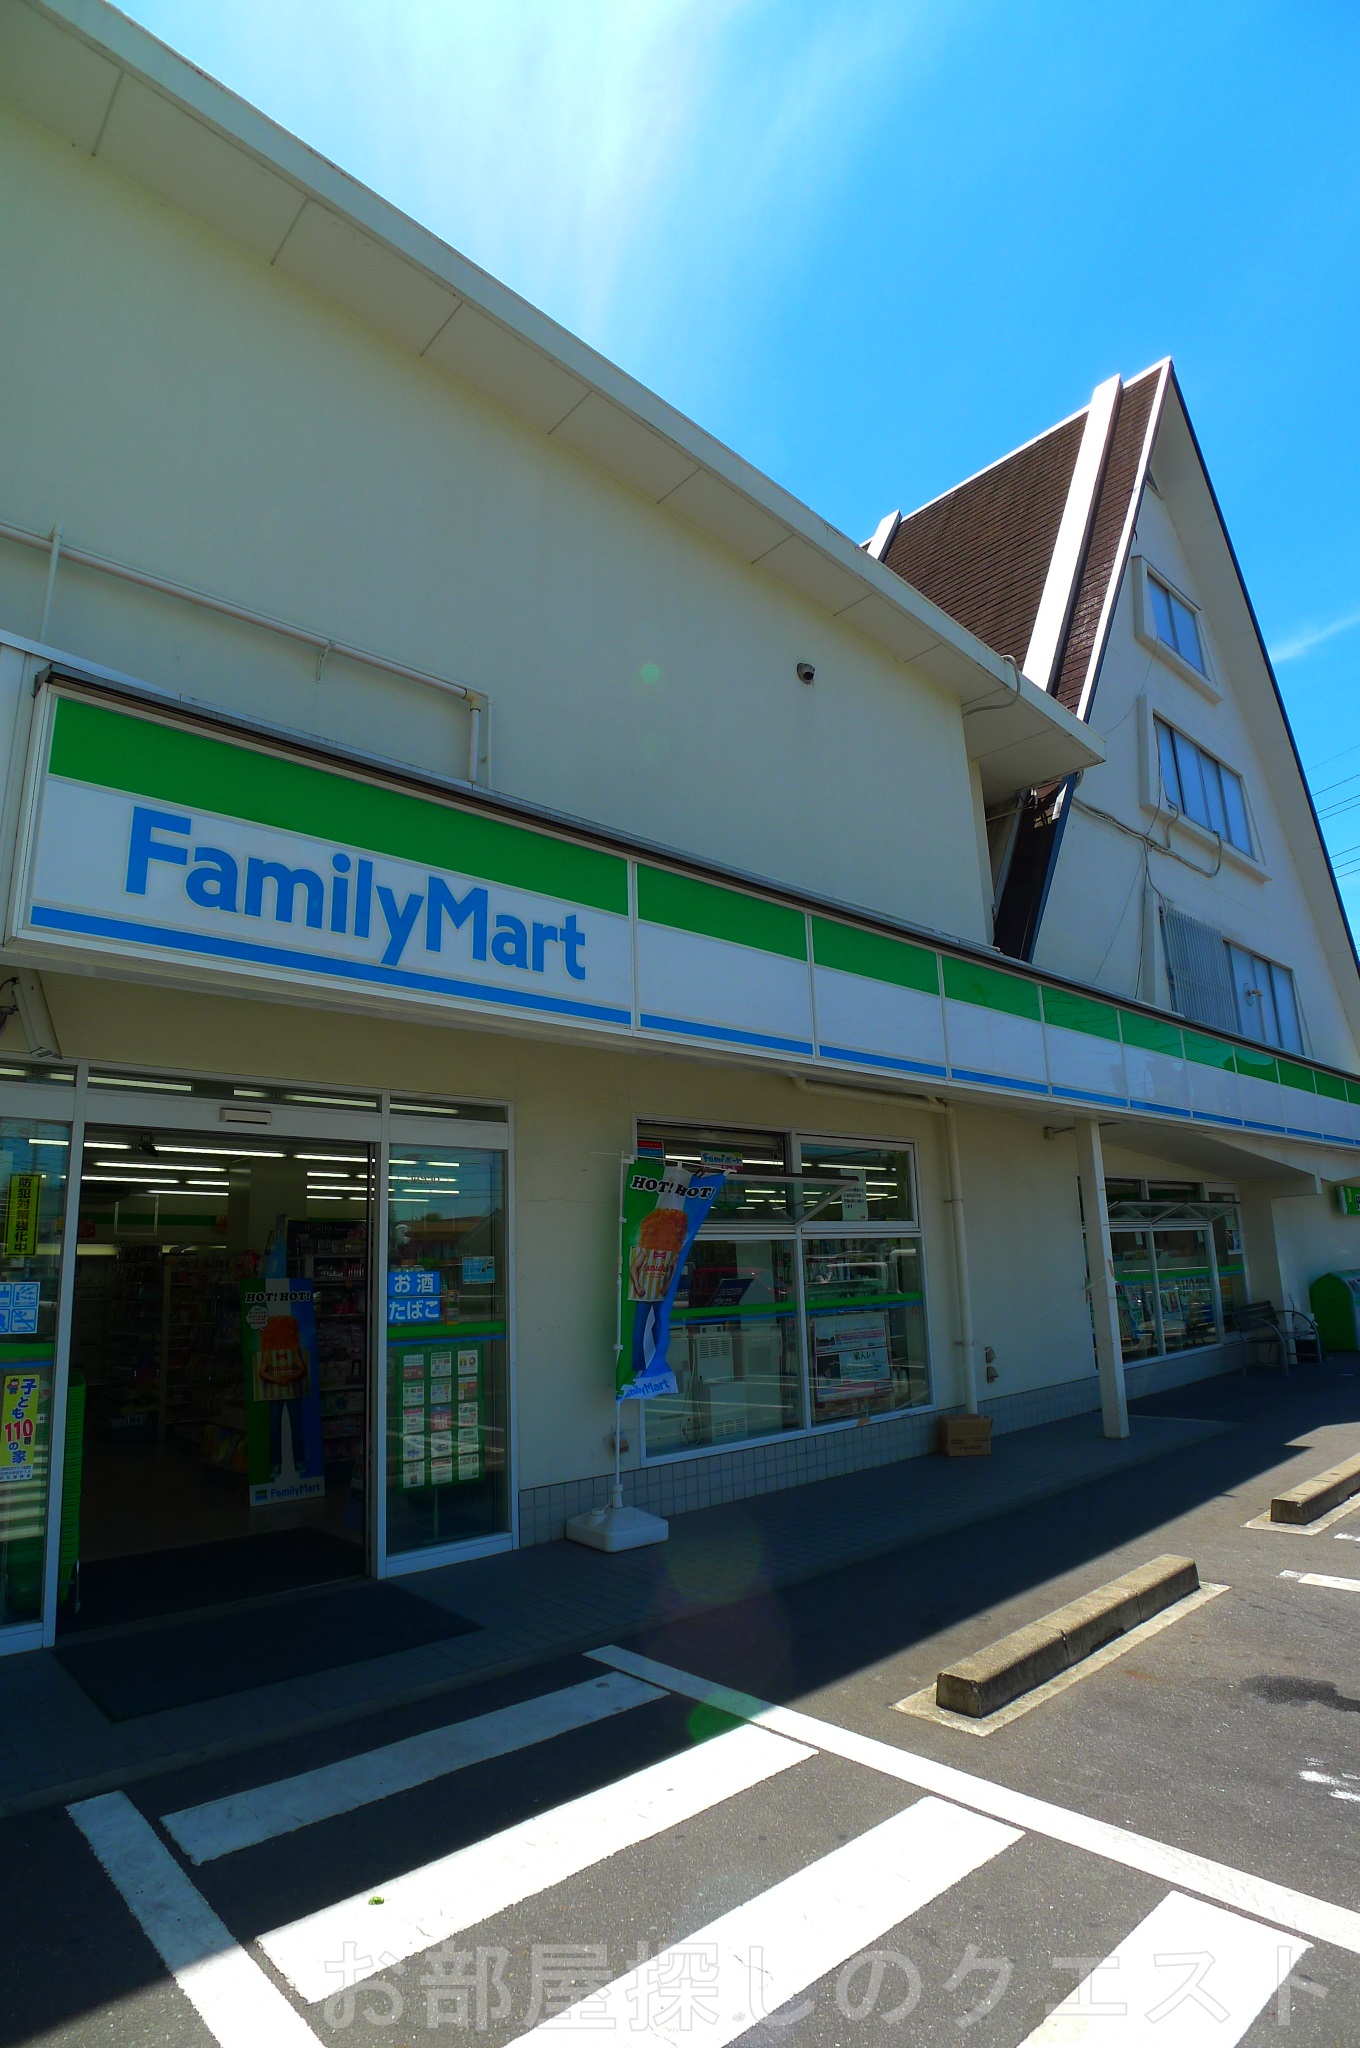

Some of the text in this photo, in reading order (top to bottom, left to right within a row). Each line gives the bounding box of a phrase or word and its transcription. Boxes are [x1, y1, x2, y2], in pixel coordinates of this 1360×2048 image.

[126, 806, 587, 981] FamilyMart
[632, 1176, 716, 1199] HOT! HOT!
[14, 1177, 31, 1253] 防犯対策強化中
[394, 1273, 435, 1294] お酒
[246, 1291, 311, 1303] HOT! HOT!
[389, 1300, 440, 1321] たばこ
[271, 1483, 320, 1498] FamilyMart
